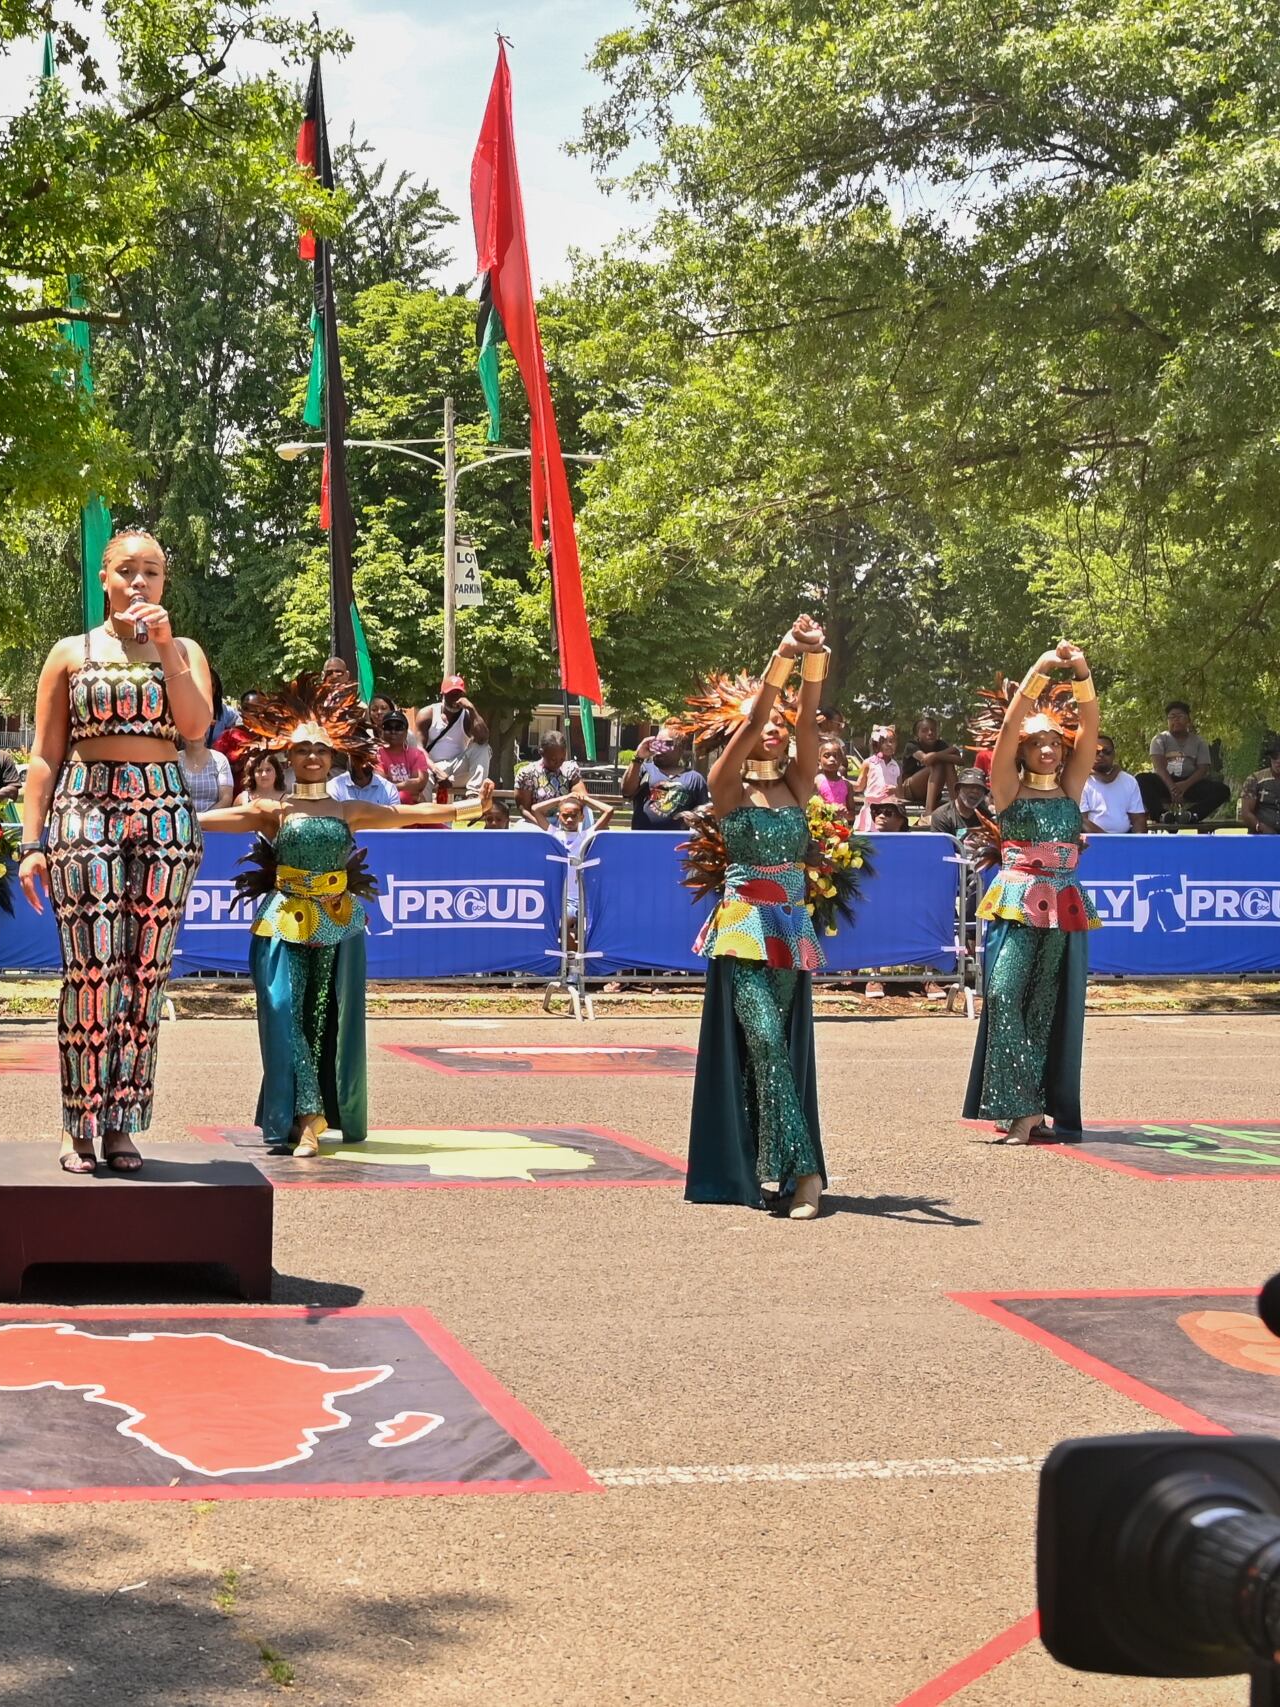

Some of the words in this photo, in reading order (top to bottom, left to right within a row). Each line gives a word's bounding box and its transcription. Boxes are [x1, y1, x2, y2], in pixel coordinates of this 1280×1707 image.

[465, 567, 476, 581] 4
[454, 584, 481, 594] PARKIN
[185, 889, 266, 921] PHI
